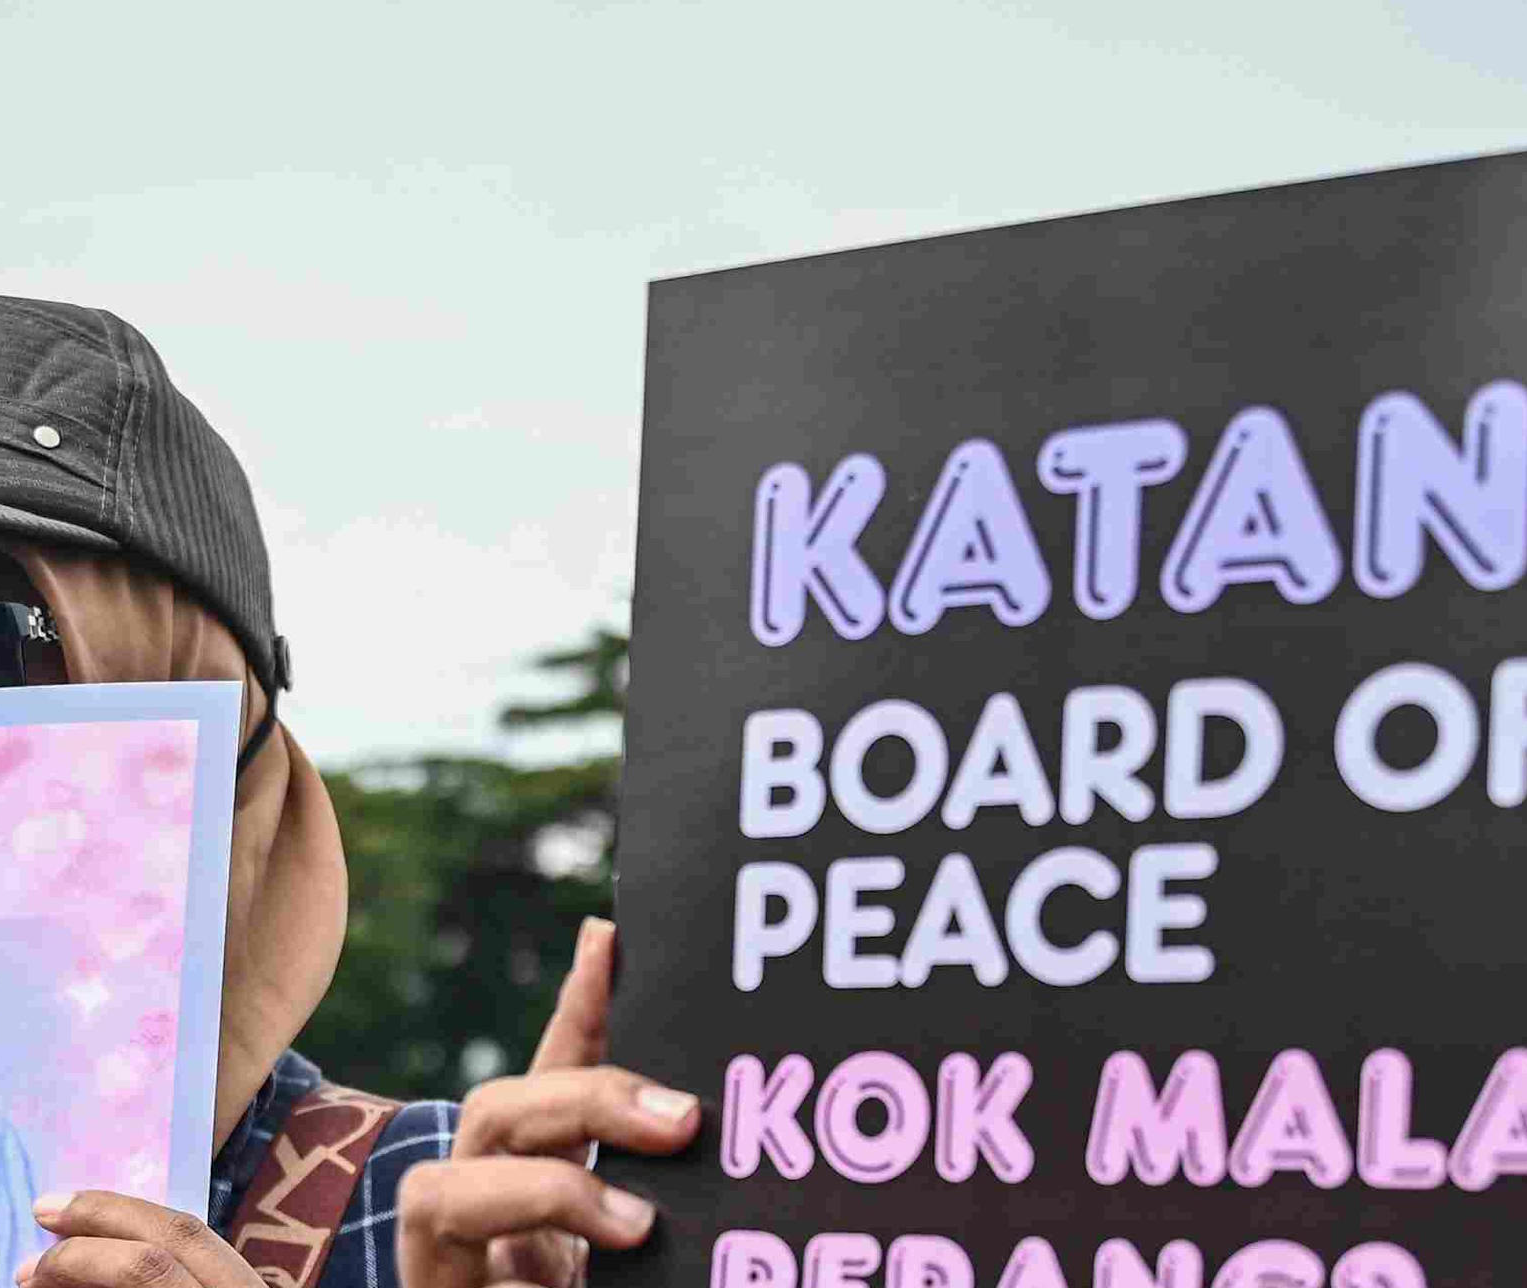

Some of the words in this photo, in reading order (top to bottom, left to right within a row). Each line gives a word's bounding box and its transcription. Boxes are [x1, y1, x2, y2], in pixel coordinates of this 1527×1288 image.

[739, 677, 1283, 839] BOARD
[732, 842, 1219, 992] PEACE
[720, 1050, 1035, 1184] KOK
